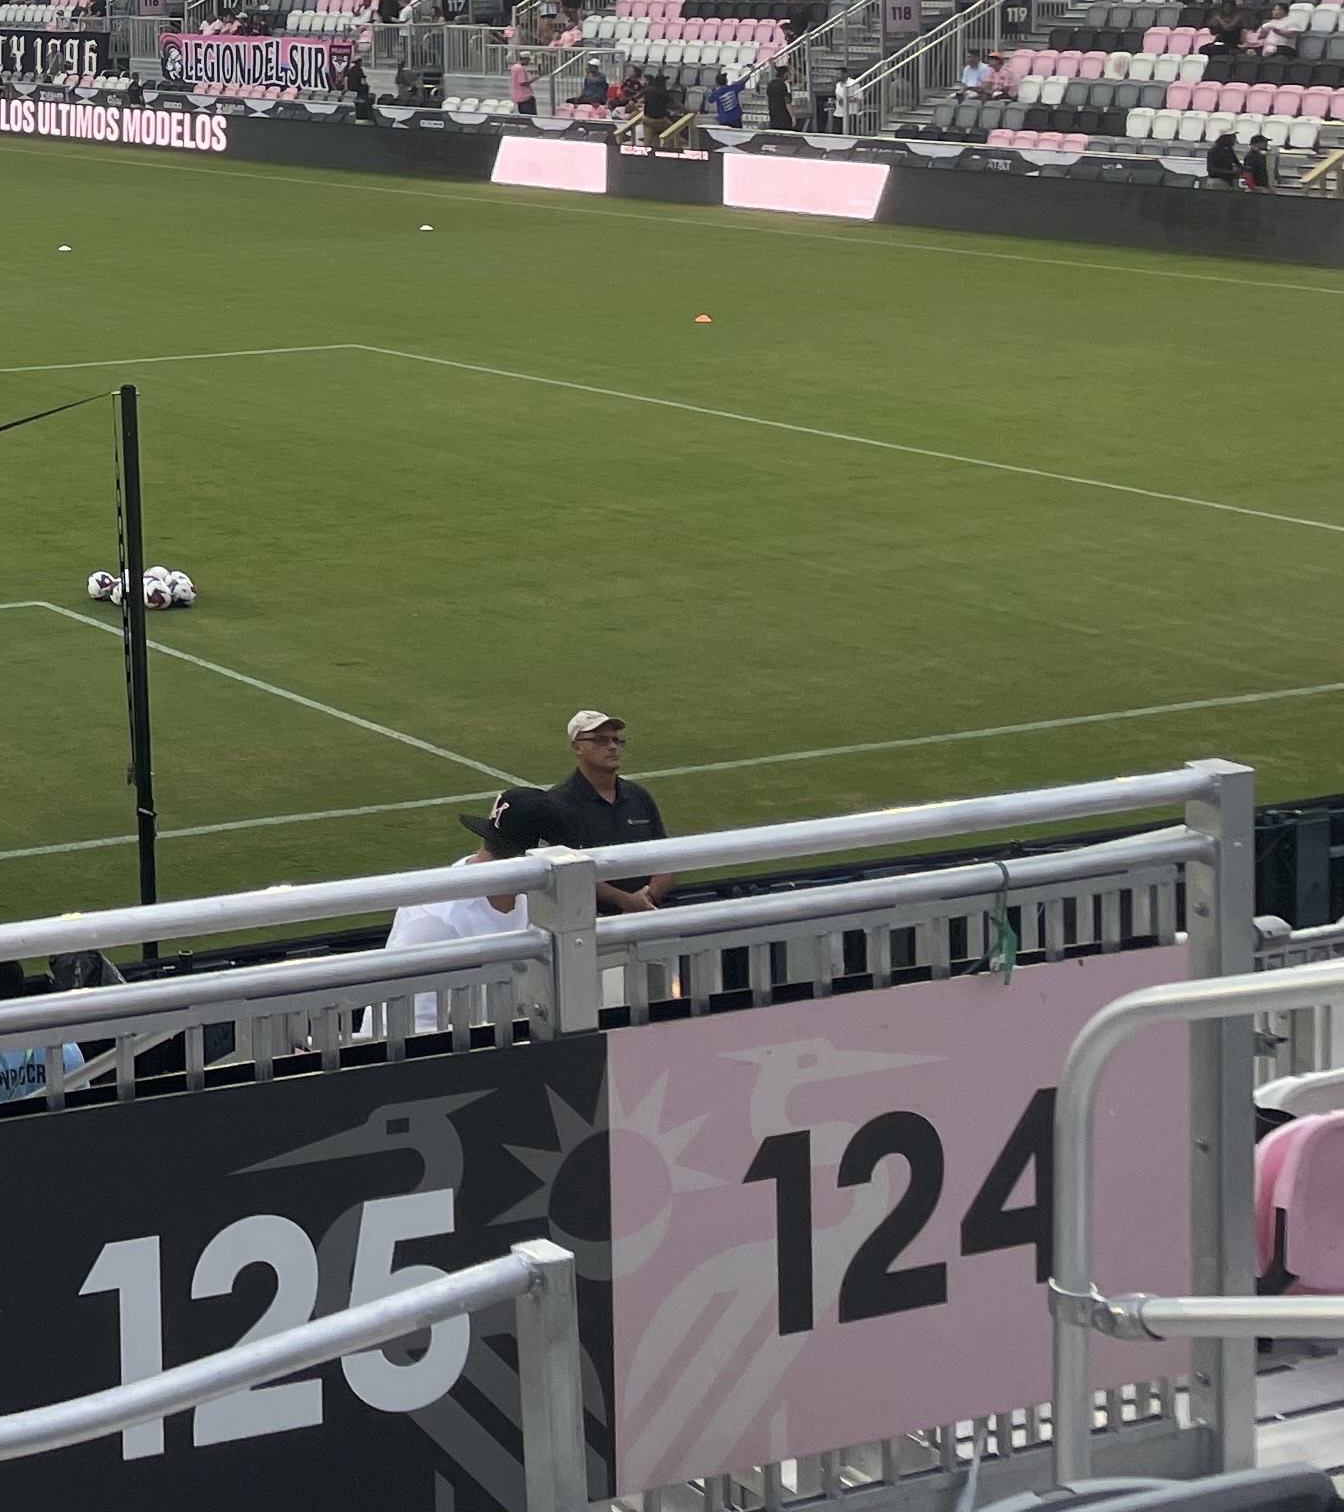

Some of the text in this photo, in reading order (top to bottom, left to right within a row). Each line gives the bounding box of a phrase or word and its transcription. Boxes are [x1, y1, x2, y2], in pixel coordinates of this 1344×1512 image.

[446, 0, 466, 12] 117
[891, 6, 912, 21] 118
[1006, 7, 1028, 23] 119
[183, 38, 329, 90] LEGION DEL SUR
[0, 98, 35, 134] LOS
[37, 101, 121, 142] ULTIMOS
[122, 107, 228, 152] MODELOS
[986, 158, 1012, 171] AT&T
[743, 1088, 1059, 1336] 124
[77, 1188, 472, 1462] 125
